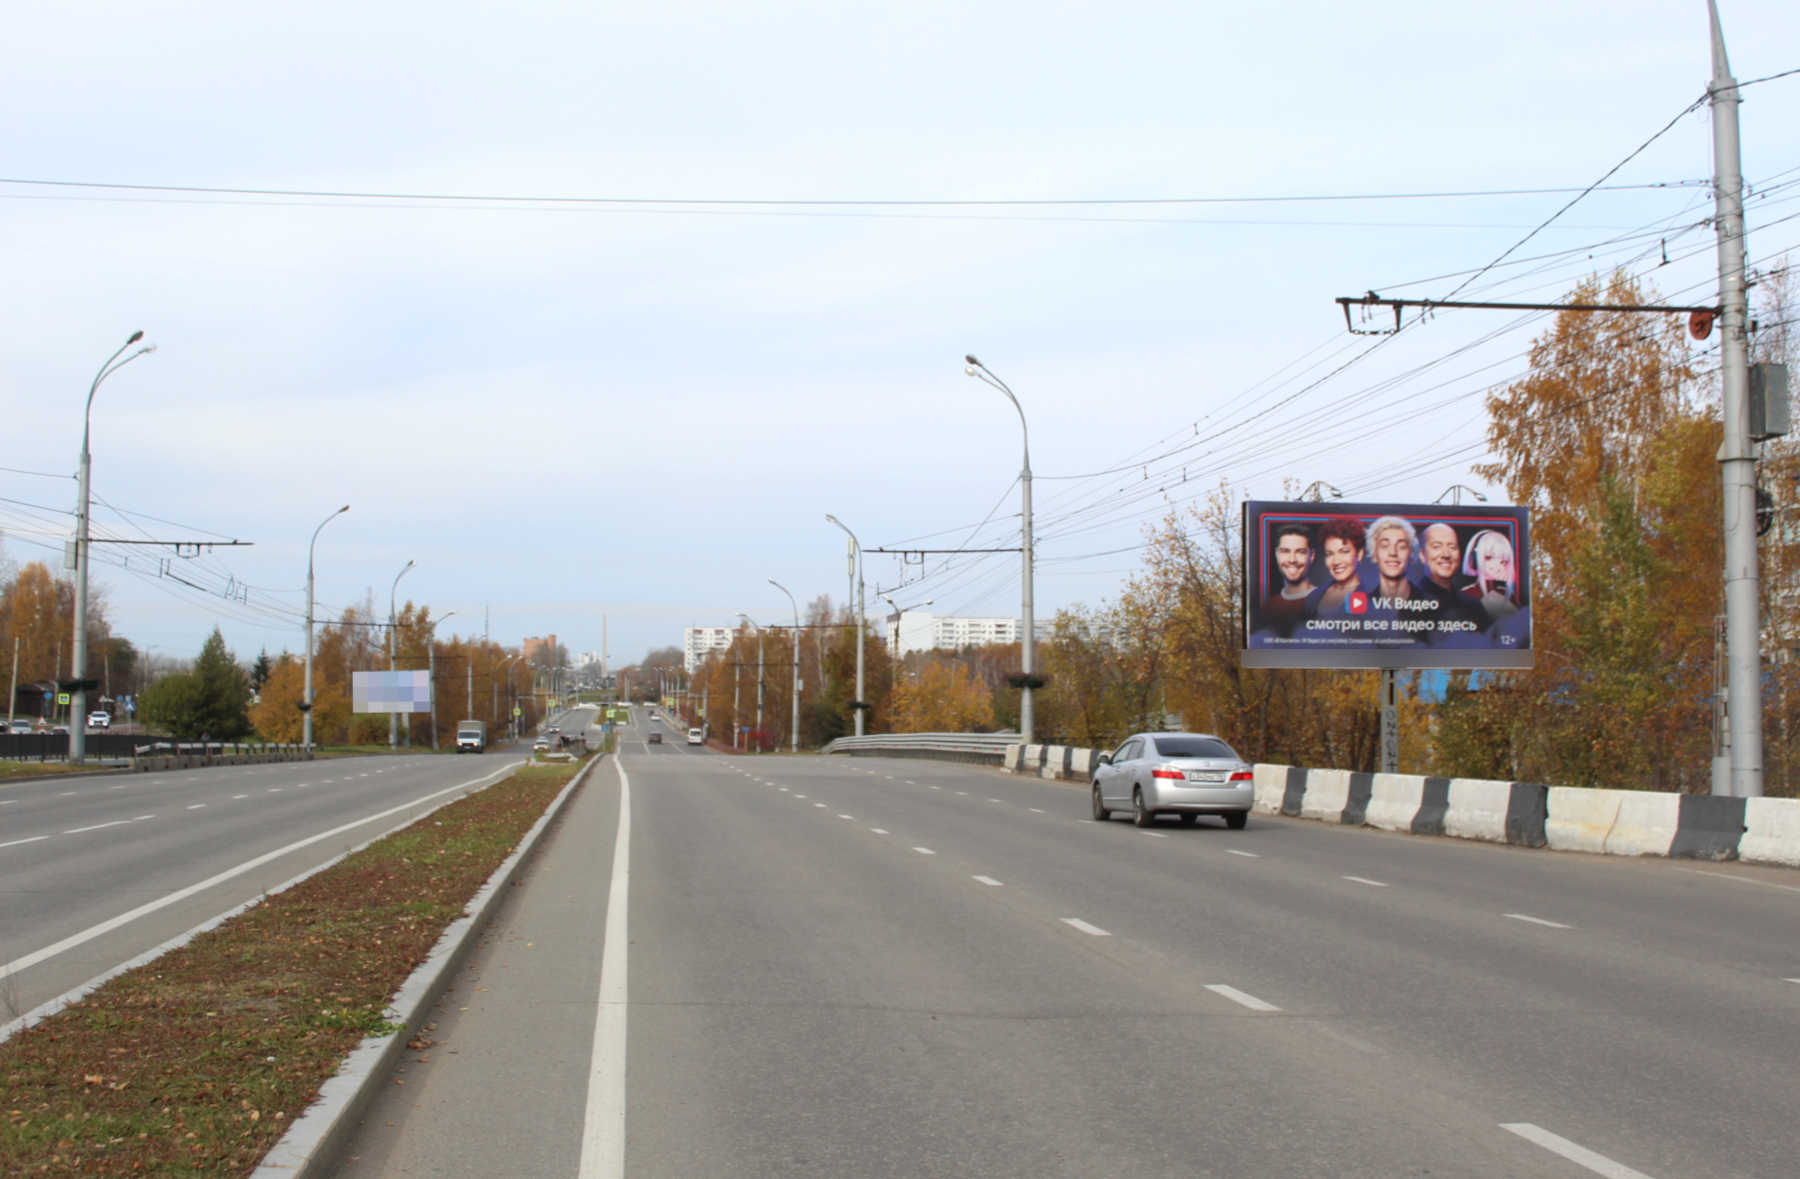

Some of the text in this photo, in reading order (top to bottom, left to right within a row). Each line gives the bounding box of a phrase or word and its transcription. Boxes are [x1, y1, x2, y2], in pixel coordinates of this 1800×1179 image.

[1372, 597, 1439, 612] VK Видео
[1306, 620, 1477, 633] смотри все видео здесь
[1500, 635, 1516, 645] 12+
